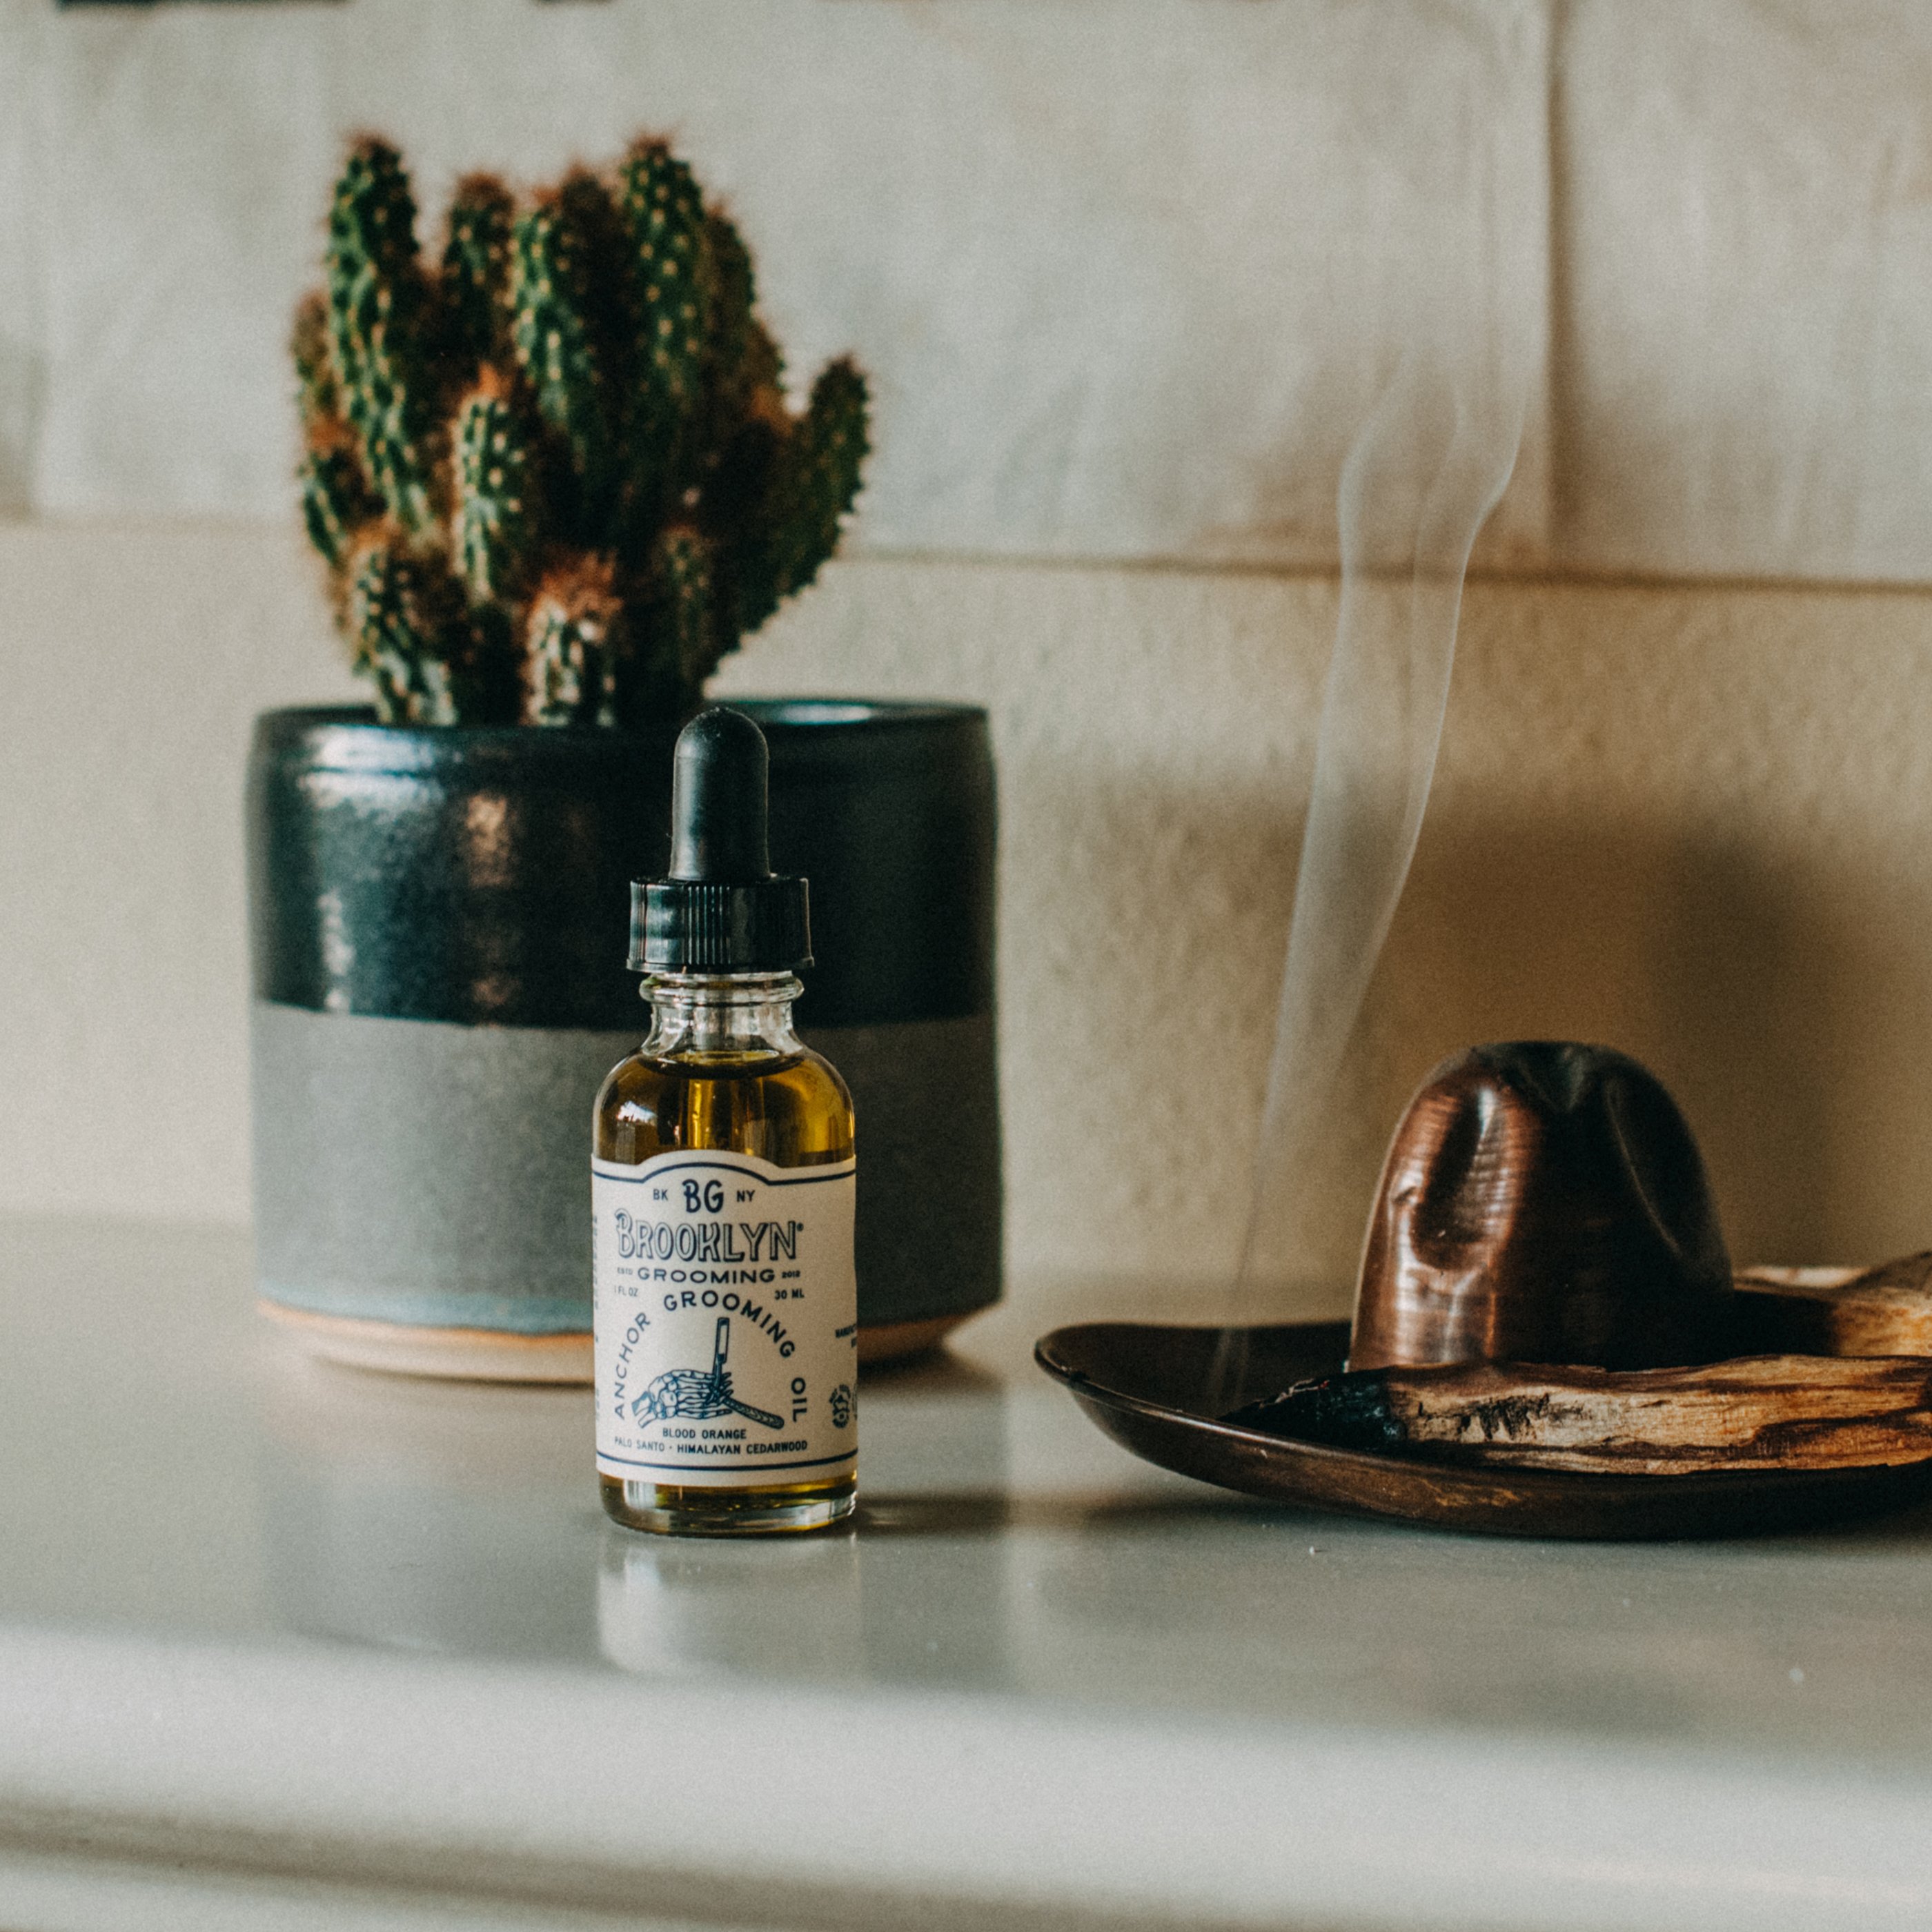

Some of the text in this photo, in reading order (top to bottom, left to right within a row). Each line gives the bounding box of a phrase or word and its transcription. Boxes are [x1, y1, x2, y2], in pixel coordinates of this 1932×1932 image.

[653, 1179, 756, 1213] BK BG NY
[638, 1267, 775, 1283] GROOMING
[782, 1270, 801, 1279] 2012
[618, 1286, 627, 1296] FL
[629, 1287, 638, 1297] OZ
[775, 1288, 805, 1300] 30 ML
[614, 1312, 651, 1420] ANCHOR
[664, 1290, 796, 1358] GROOMING
[791, 1377, 807, 1423] OIL
[662, 1428, 747, 1439] BLOOD ORANGE
[614, 1436, 807, 1455] PALO SANTO HIMALAYAN CEDARWOOD
